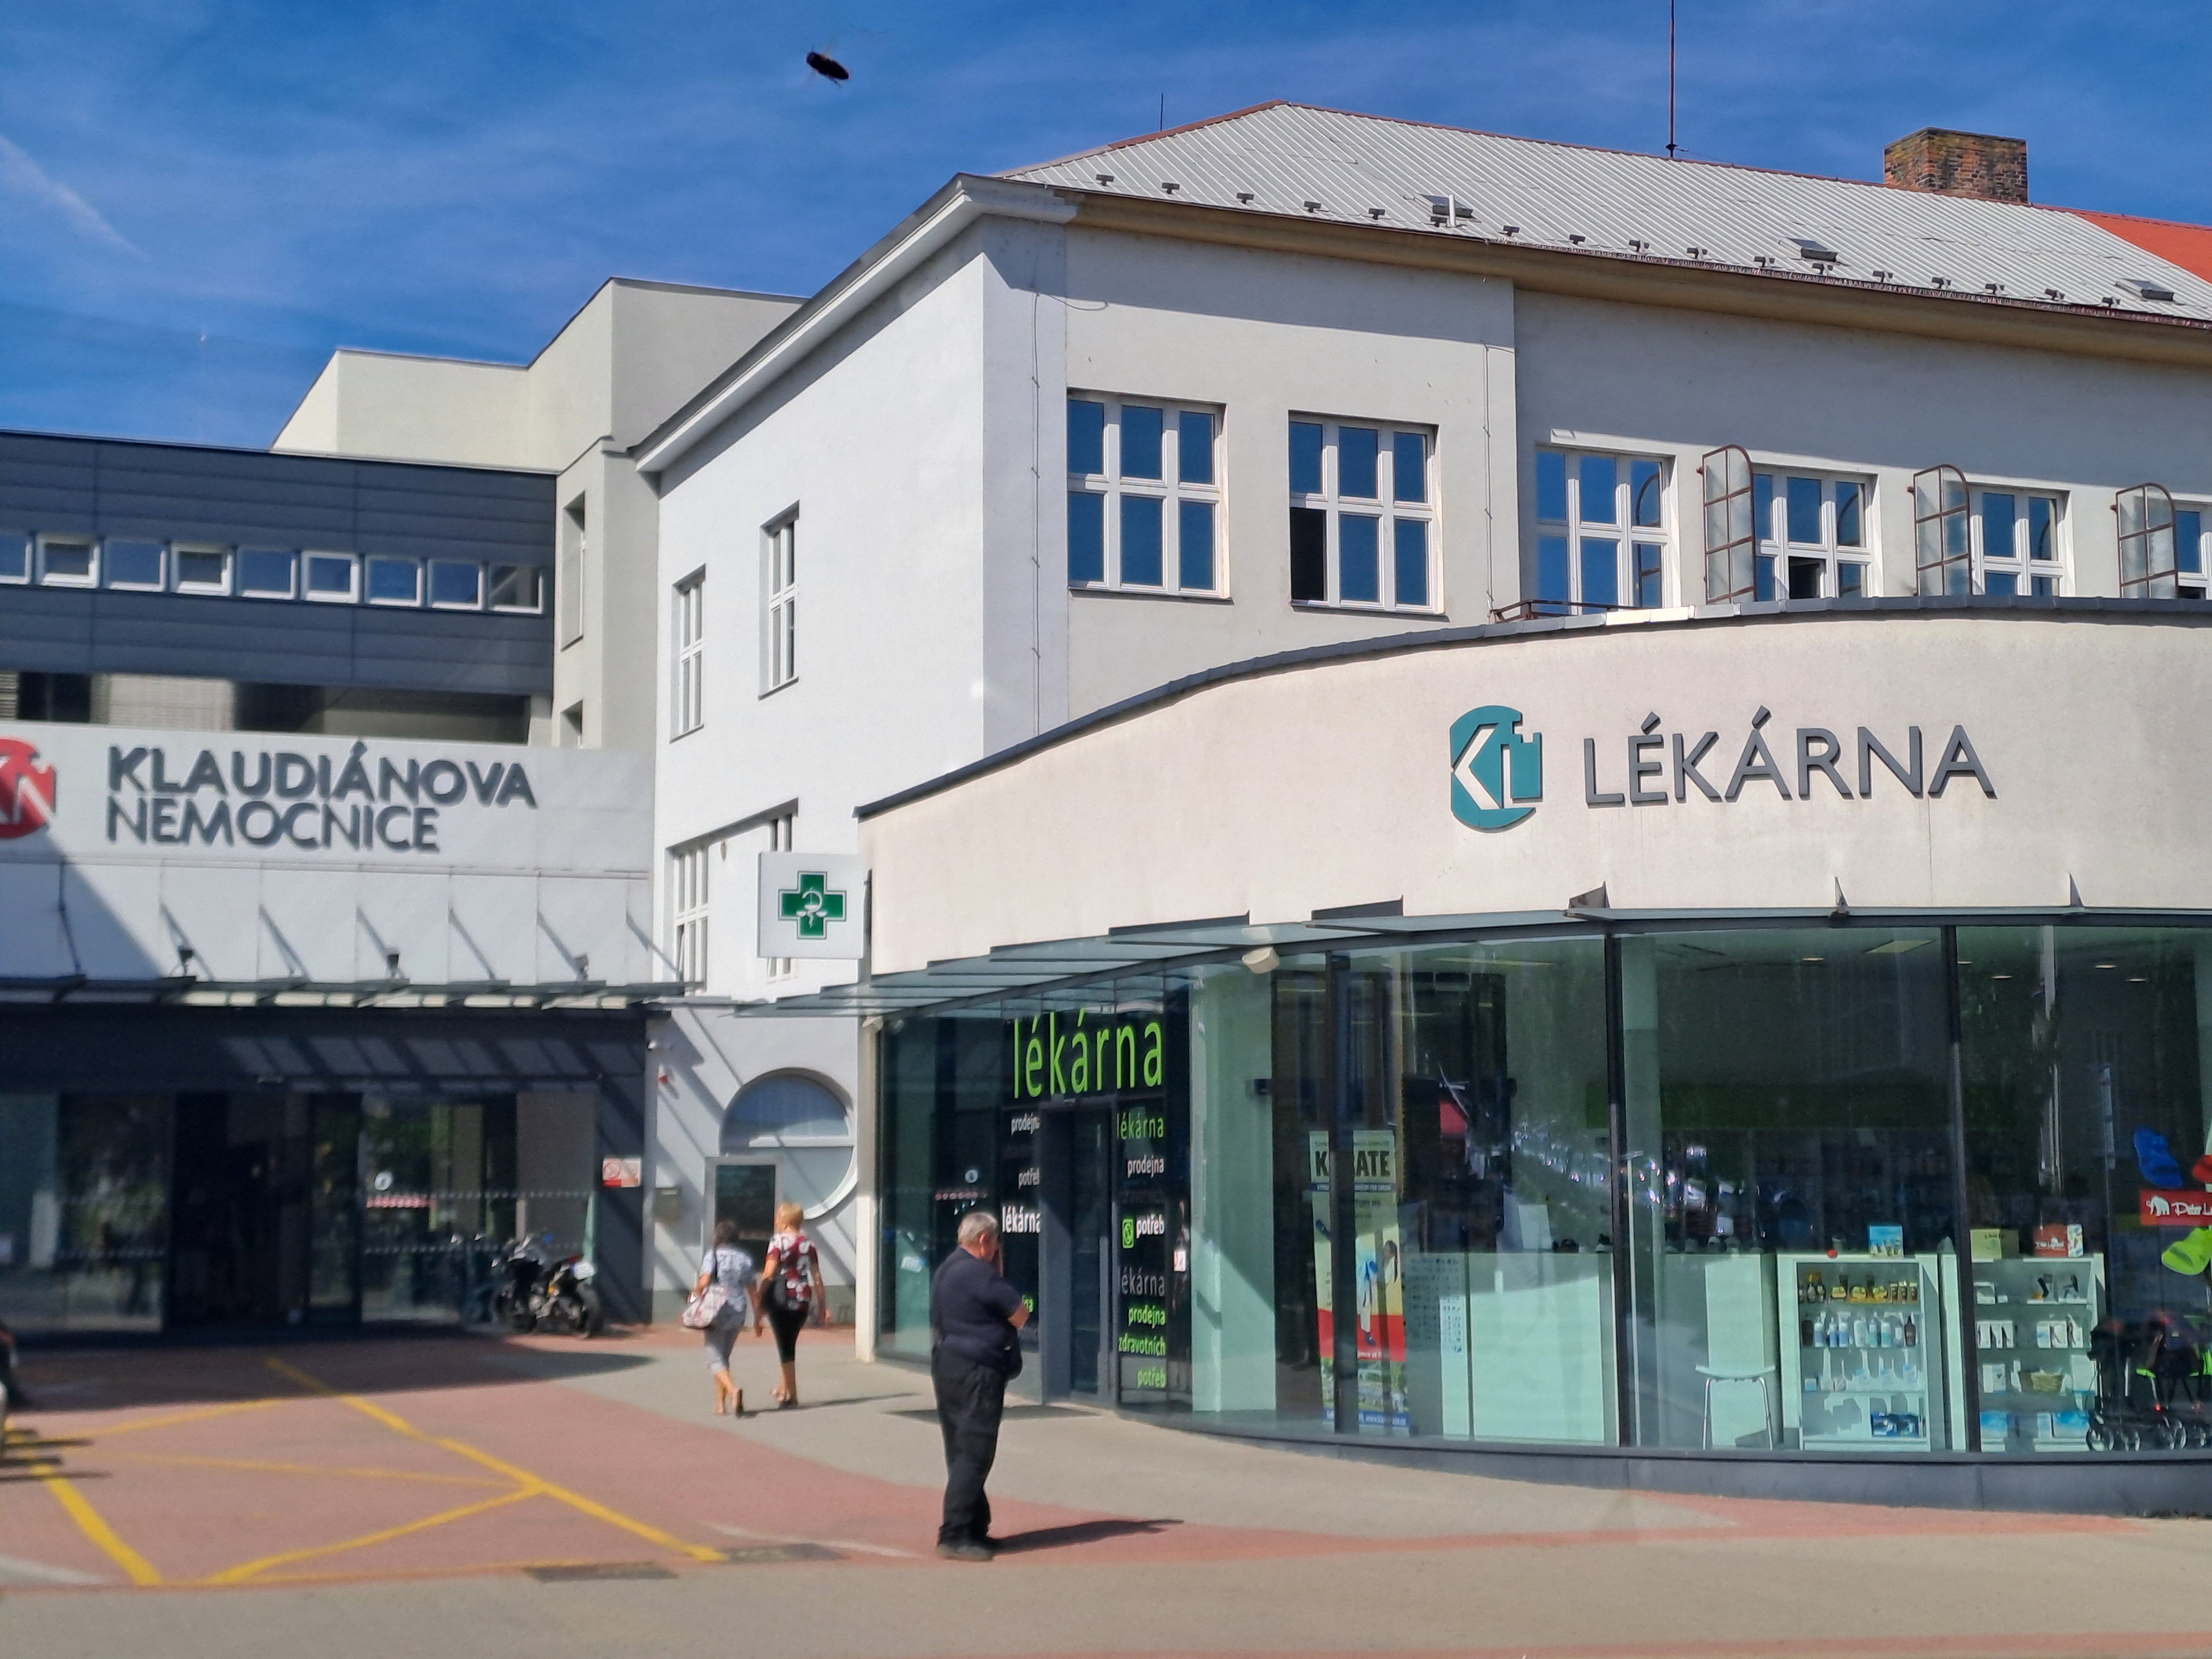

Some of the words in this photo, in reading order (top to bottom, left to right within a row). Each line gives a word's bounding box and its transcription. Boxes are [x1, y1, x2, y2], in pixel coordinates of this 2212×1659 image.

[1583, 706, 1997, 807] LÉKÁRNA
[107, 740, 537, 808] KLAUDIÁNOVA
[107, 795, 440, 852] NEMOCNICE
[1014, 1007, 1162, 1099] lékárna
[1117, 1112, 1164, 1140] lékárna
[1127, 1154, 1164, 1178] prodejna
[1315, 1150, 1390, 1177] KATE
[1136, 1213, 1165, 1239] potřeb
[1128, 1305, 1166, 1329] prodejna
[1118, 1332, 1166, 1357] zdravotních
[1138, 1367, 1167, 1389] potřeb
